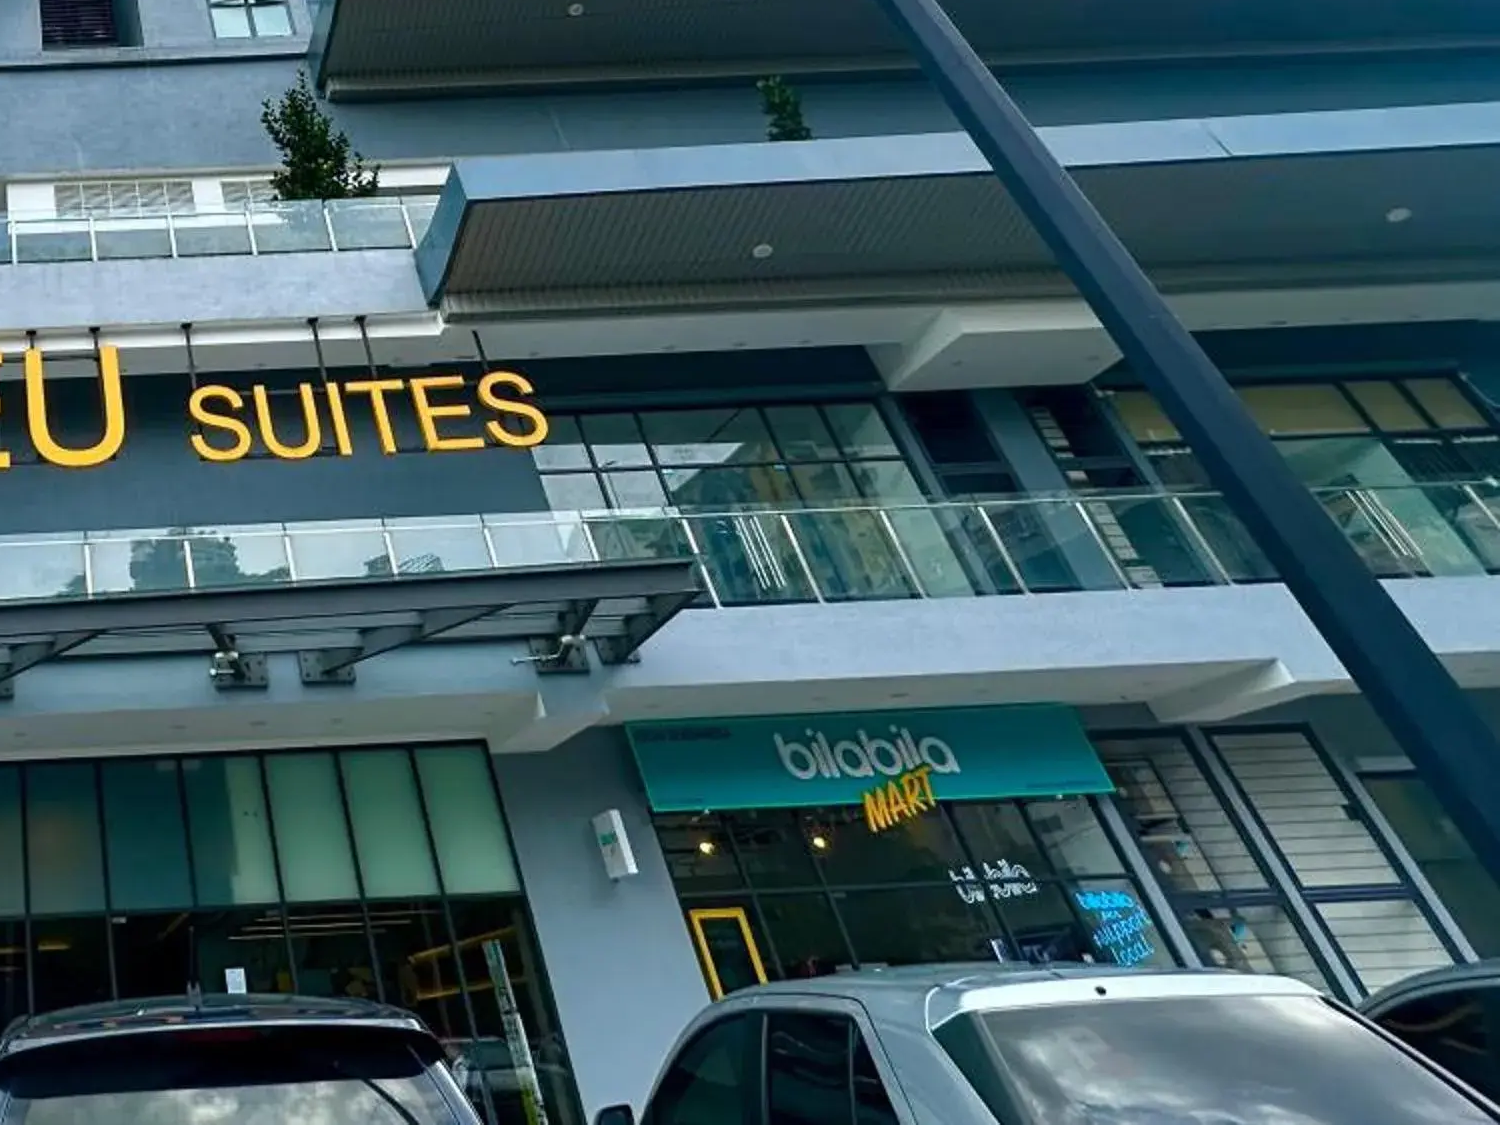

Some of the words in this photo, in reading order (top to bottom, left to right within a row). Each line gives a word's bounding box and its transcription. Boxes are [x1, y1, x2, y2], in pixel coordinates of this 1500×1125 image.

[188, 370, 549, 462] SUITES
[773, 724, 961, 780] bilabila
[863, 763, 936, 832] MART
